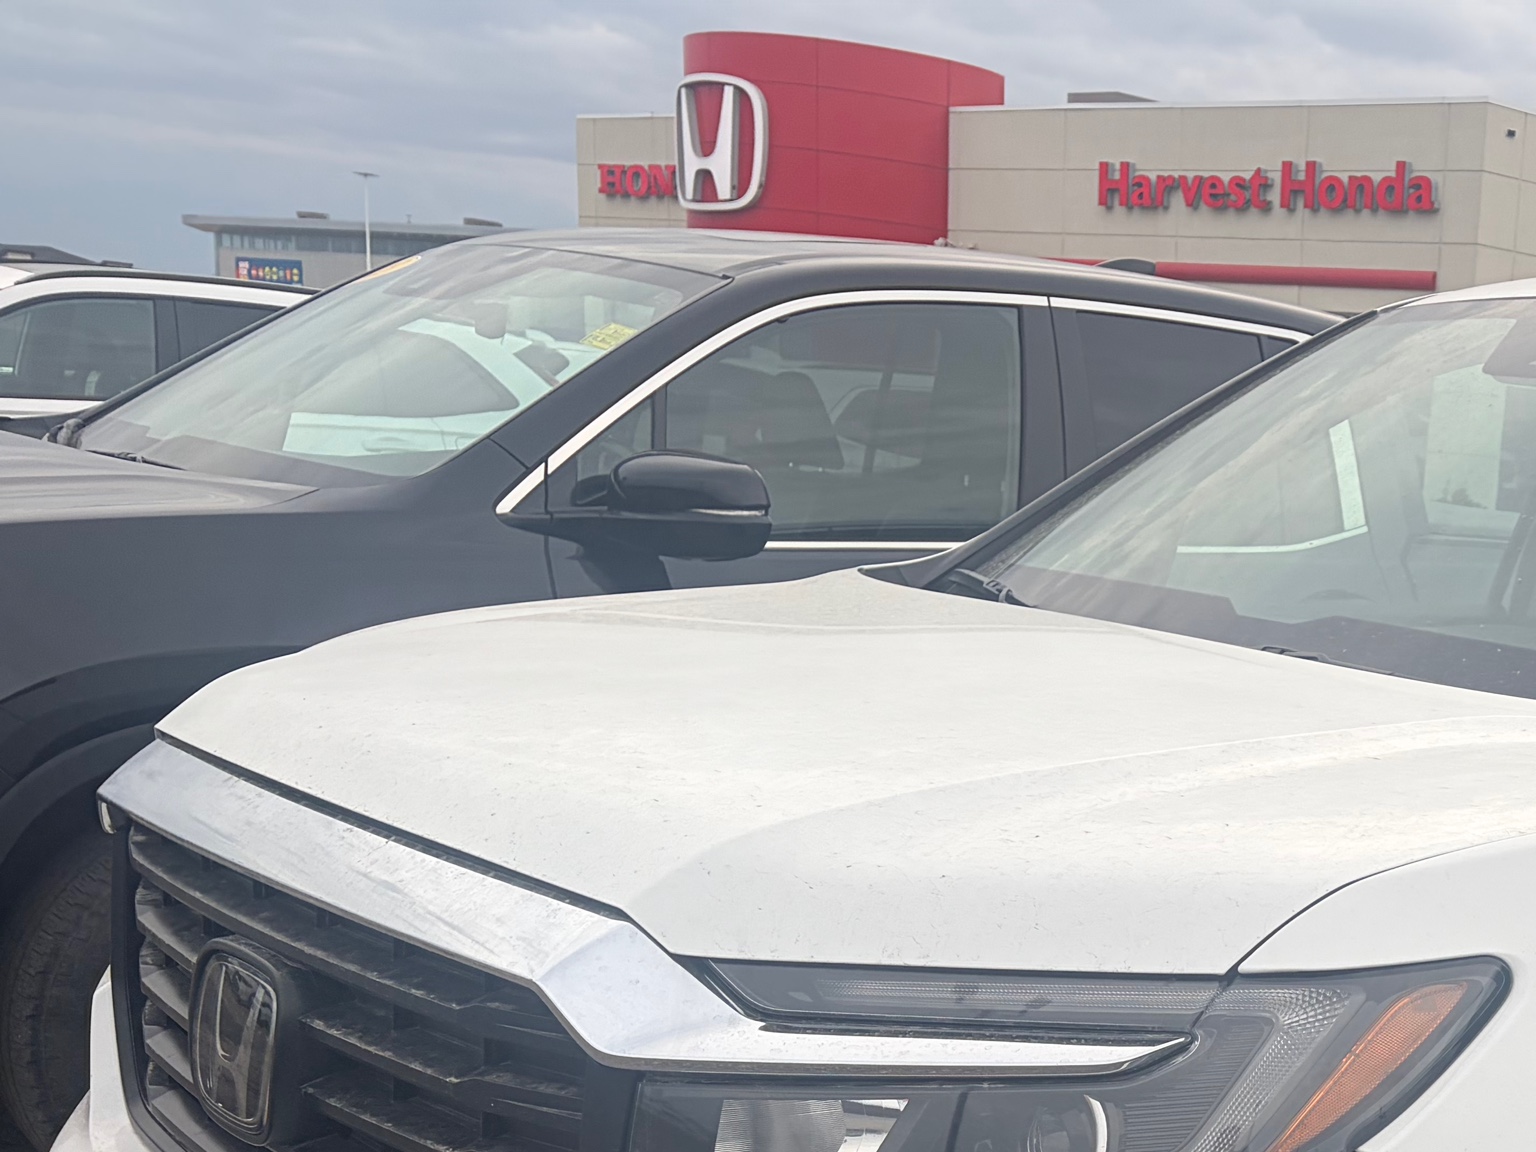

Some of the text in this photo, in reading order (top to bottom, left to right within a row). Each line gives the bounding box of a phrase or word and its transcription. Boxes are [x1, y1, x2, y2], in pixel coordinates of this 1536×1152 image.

[598, 164, 676, 198] HON
[1098, 160, 1435, 211] Harvest Honda
